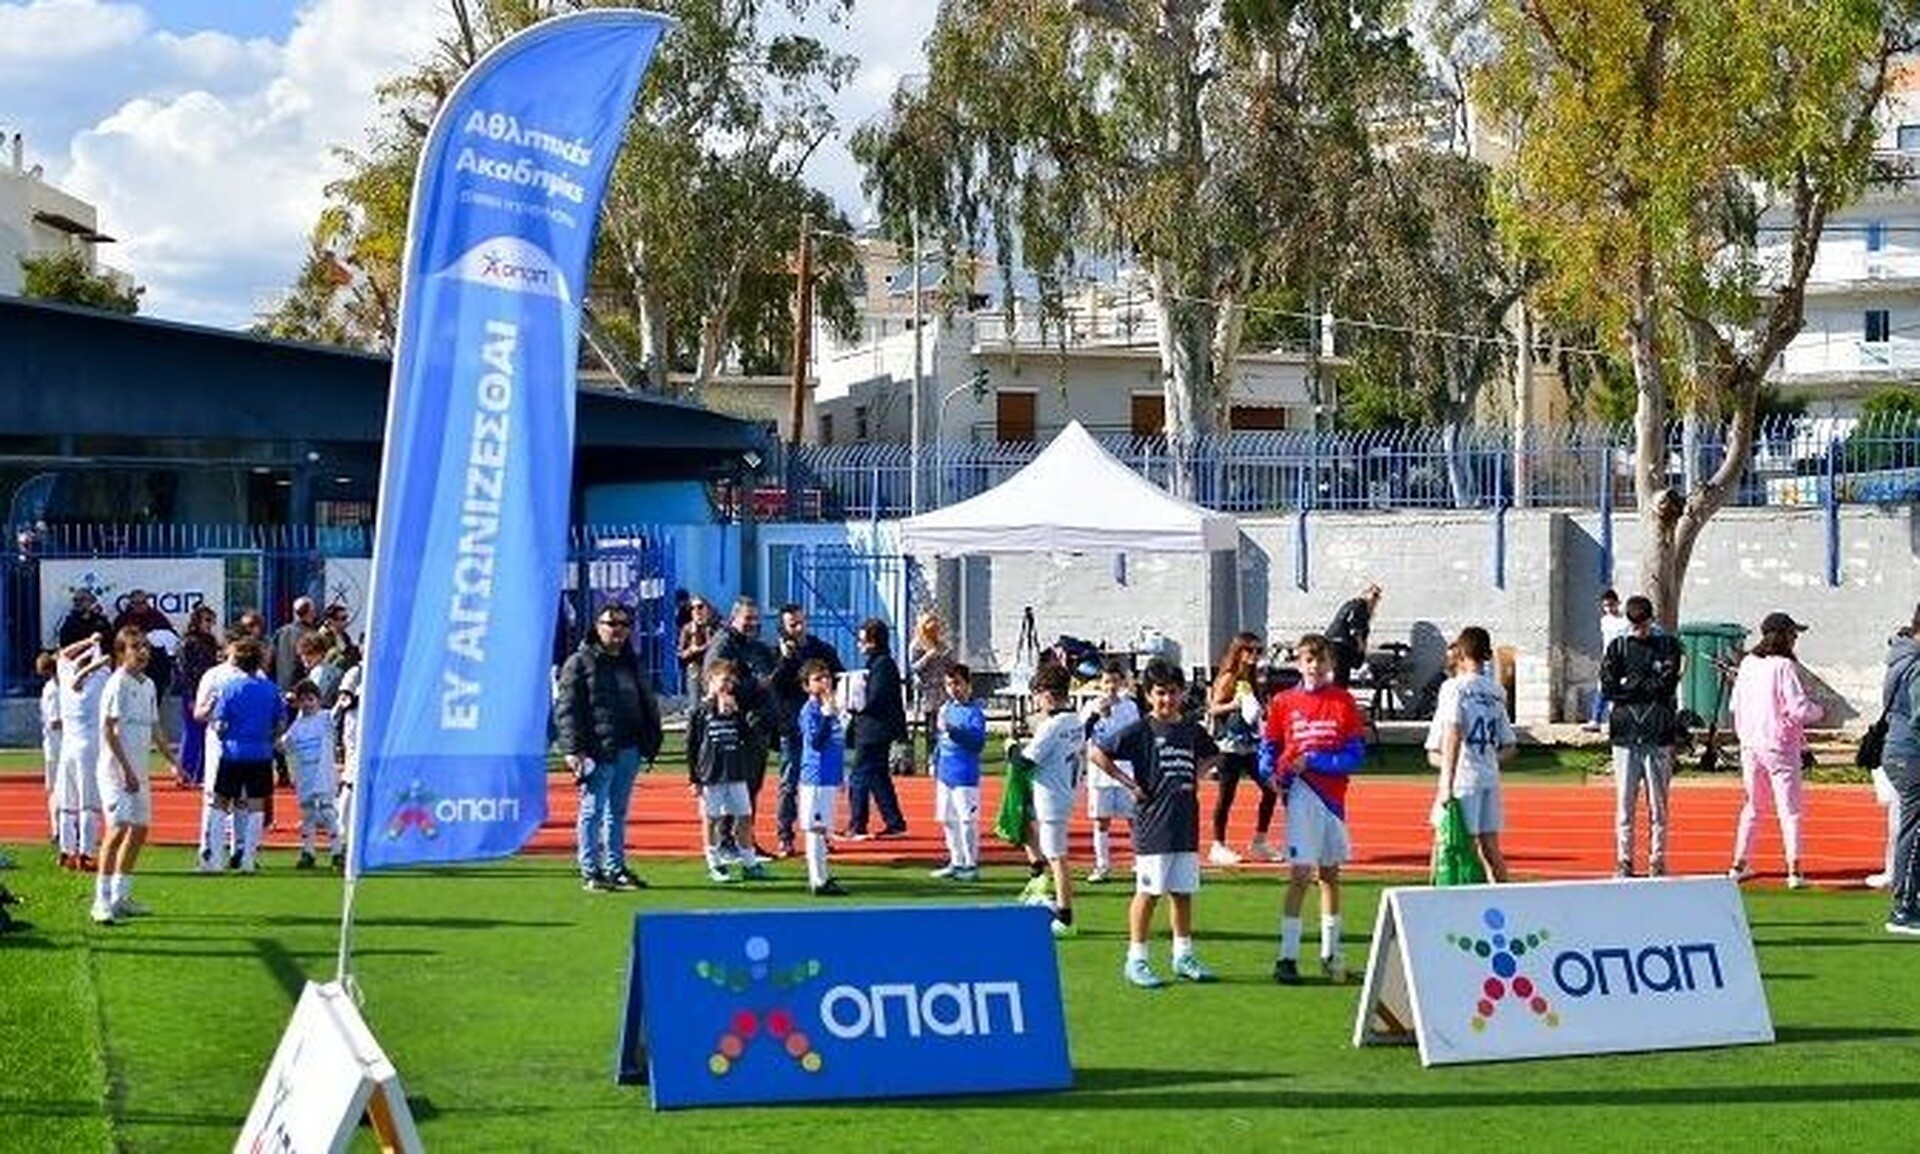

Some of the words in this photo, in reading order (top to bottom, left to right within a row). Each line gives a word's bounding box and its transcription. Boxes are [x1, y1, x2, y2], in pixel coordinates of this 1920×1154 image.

[448, 319, 519, 662] ΑΓΩΝΙΖΕΣΘΑΙ
[440, 665, 482, 731] ΕΥ
[1552, 943, 1724, 997] οπαπ
[820, 981, 1024, 1039] οπαπ
